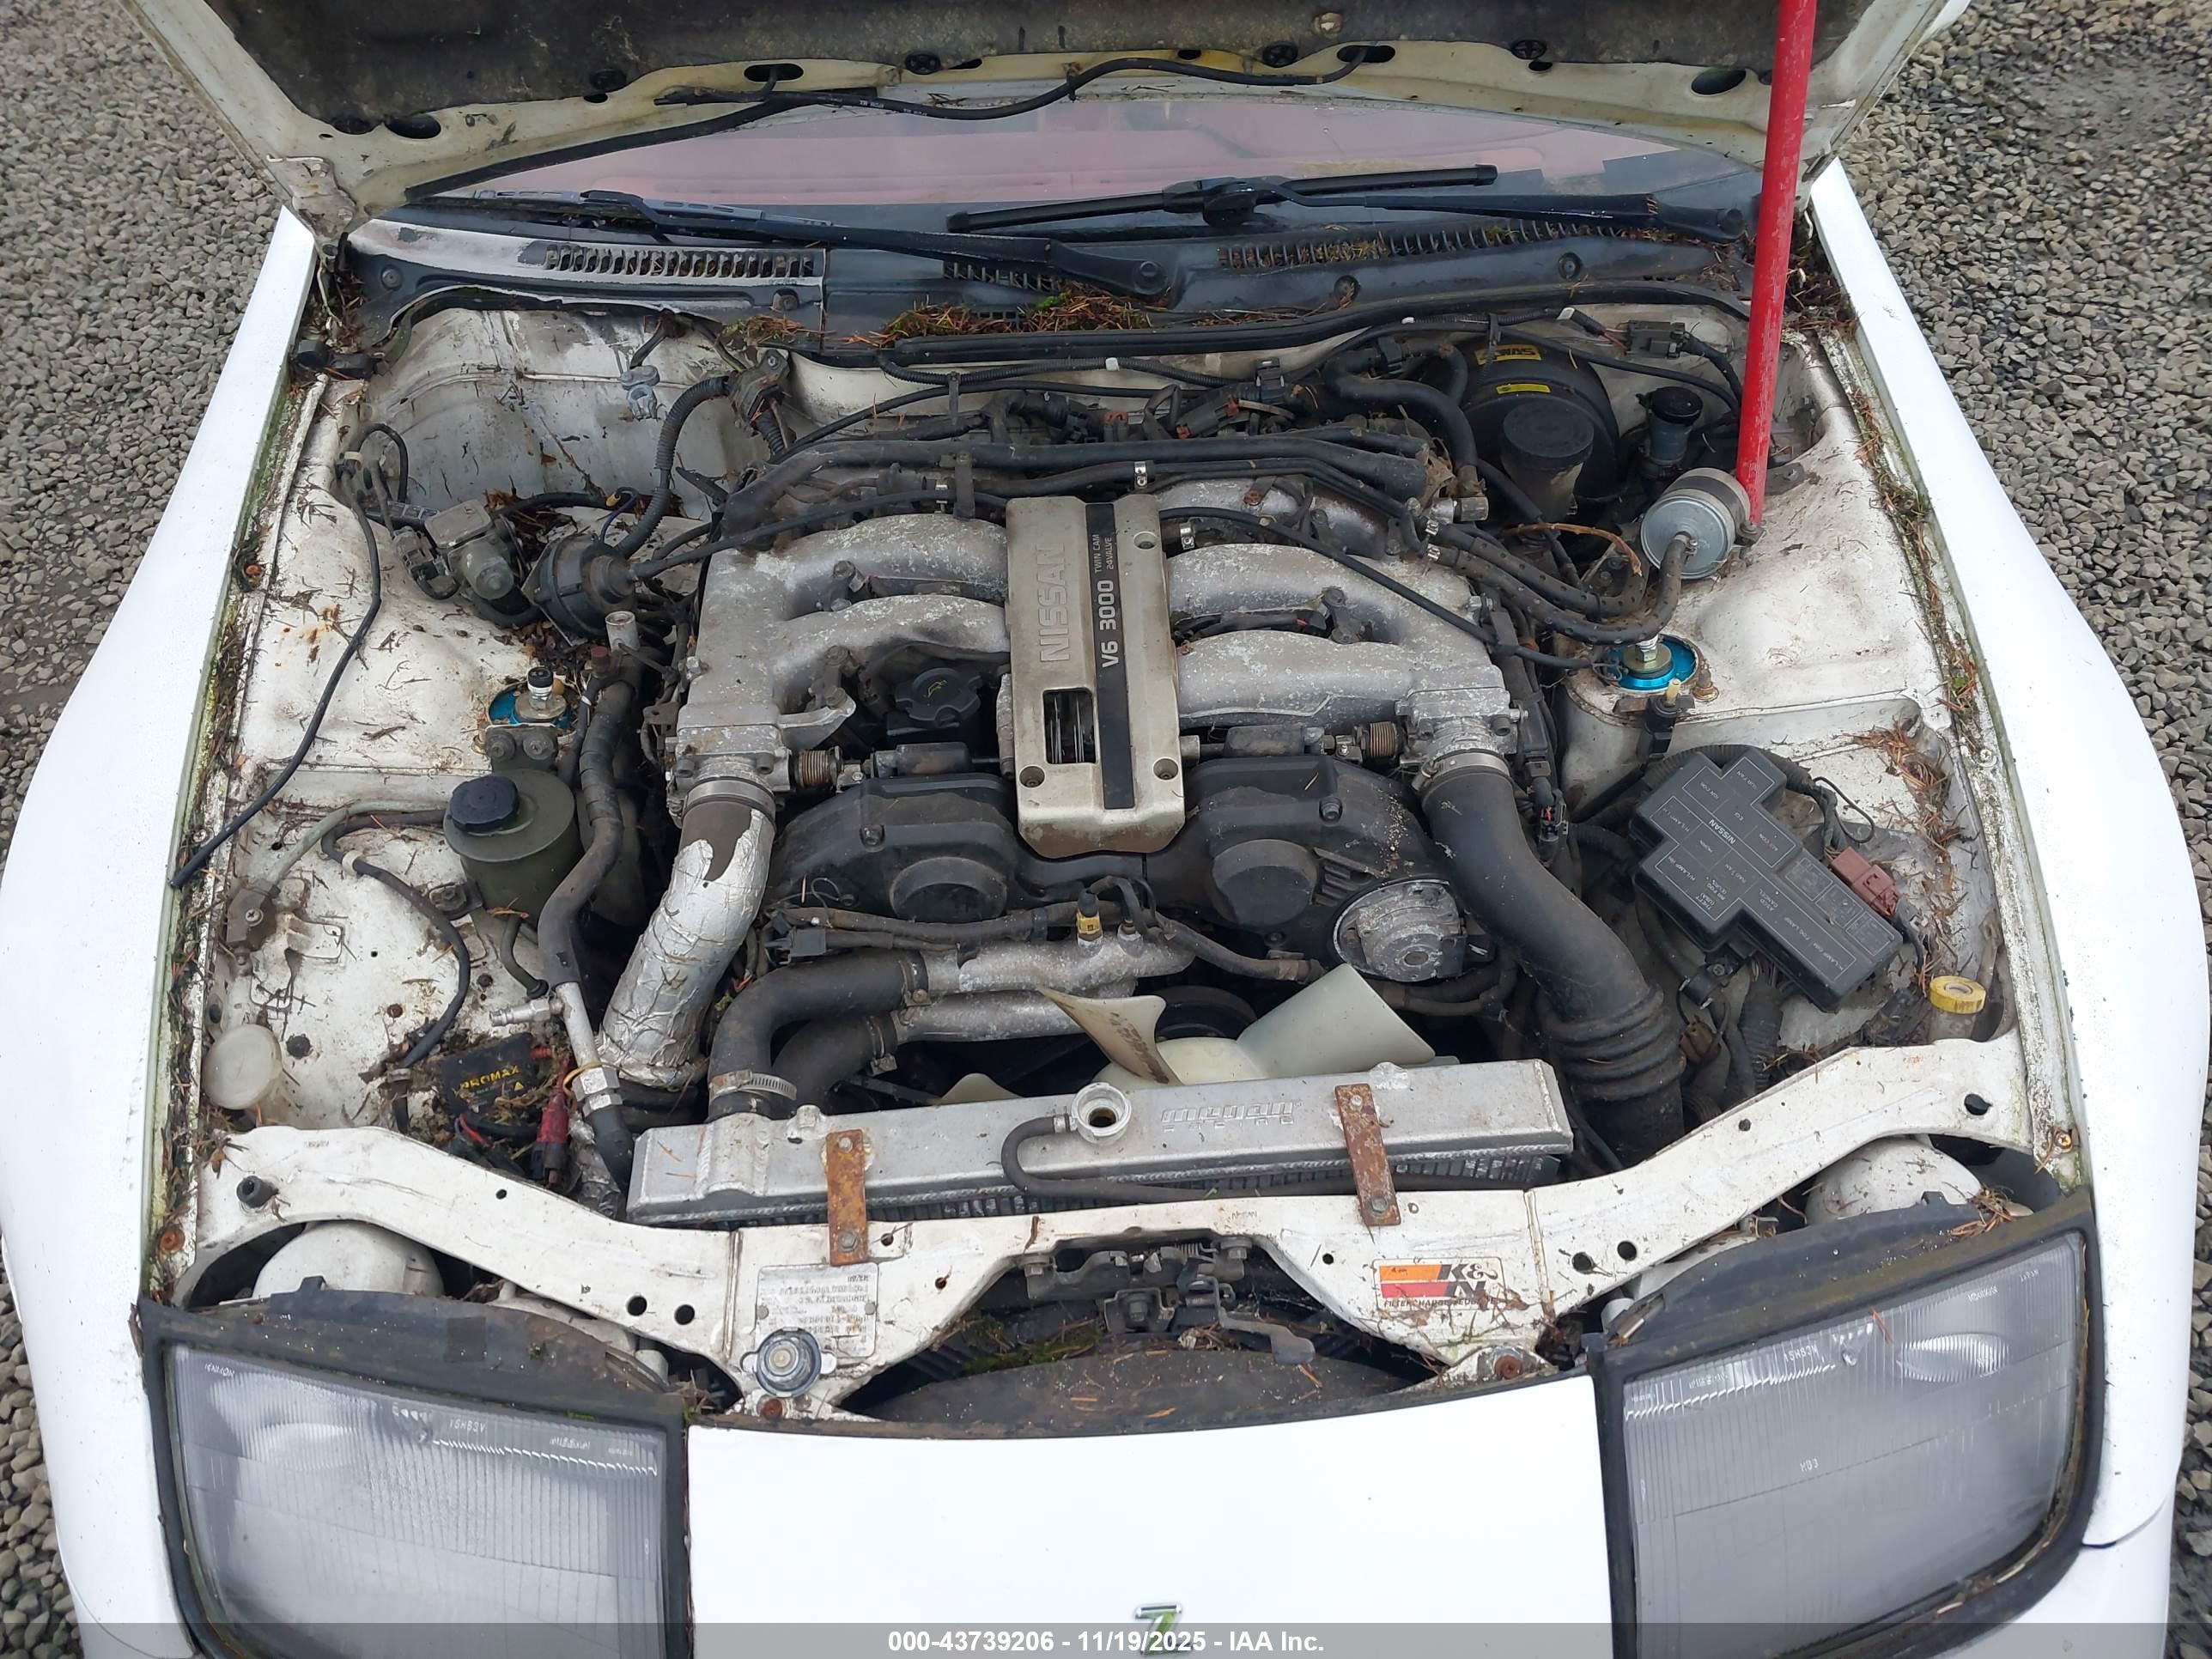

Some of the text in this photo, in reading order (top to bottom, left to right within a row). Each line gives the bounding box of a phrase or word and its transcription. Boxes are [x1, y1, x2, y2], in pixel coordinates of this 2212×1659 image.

[1092, 534, 1101, 550] CAM
[1036, 543, 1070, 663] NISSAN
[1097, 580, 1120, 668] V6 3000
[1708, 817, 1736, 844] NISSAN
